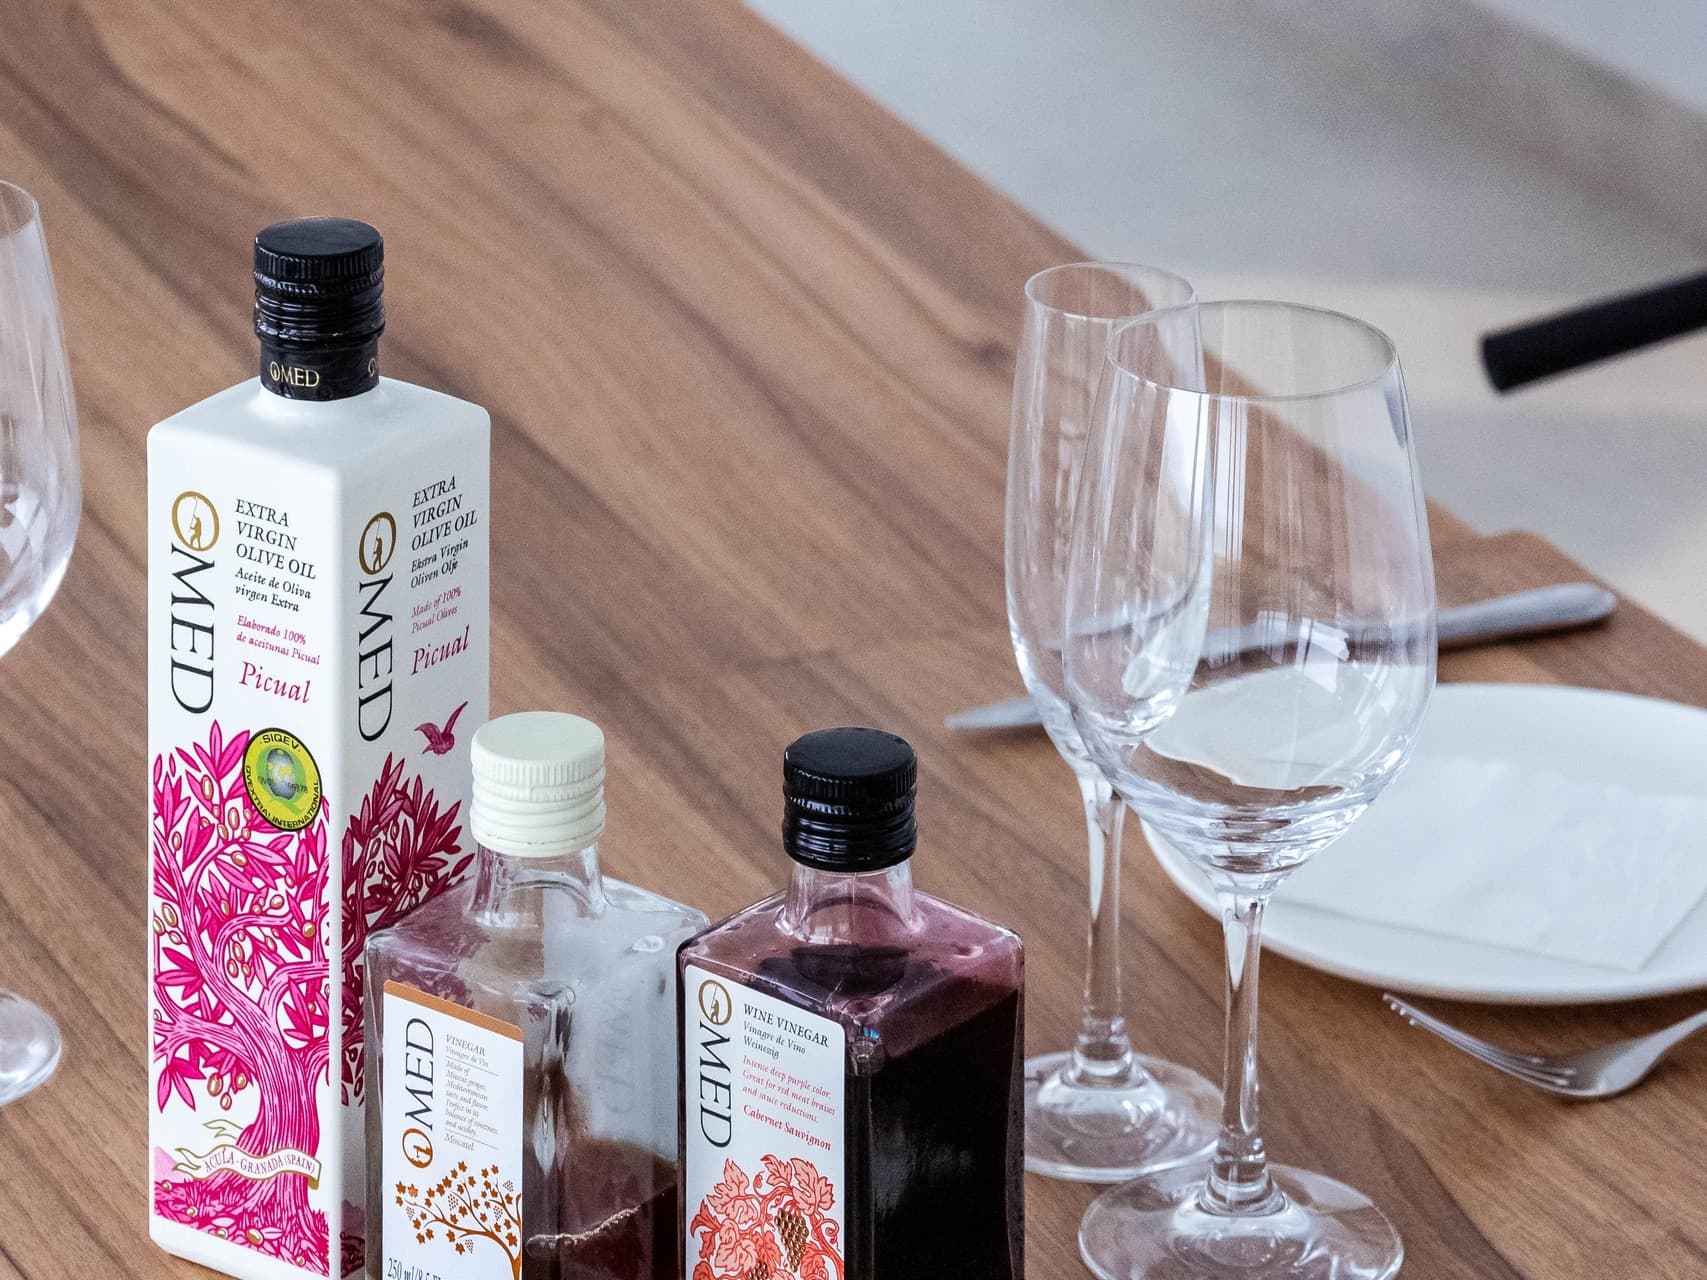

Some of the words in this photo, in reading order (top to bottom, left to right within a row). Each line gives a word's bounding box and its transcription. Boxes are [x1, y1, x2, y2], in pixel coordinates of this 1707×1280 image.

[270, 361, 319, 387] OMED
[412, 475, 456, 508] EXTRA
[235, 498, 289, 527] EXTRA
[412, 494, 463, 528] VIRGIN
[237, 521, 298, 551] VIRGIN
[411, 522, 452, 551] OLIVE
[454, 509, 478, 532] OIL
[236, 543, 284, 570] OLIVE
[289, 559, 317, 579] OIL
[411, 554, 437, 573] Ekstra
[440, 538, 469, 559] Virgin
[235, 567, 266, 585] Aceite
[268, 577, 280, 589] de
[282, 581, 311, 599] Oliva
[410, 571, 438, 589] Oliven
[441, 558, 458, 575] Olje
[171, 491, 219, 714] OMED
[235, 584, 268, 601] virgen
[270, 593, 299, 612] Extra
[412, 601, 433, 618] Made
[433, 594, 442, 610] of
[442, 586, 462, 603] 100%
[237, 615, 280, 637] Elaborado
[283, 629, 306, 645] 100%
[359, 512, 397, 741] OMED
[412, 613, 435, 634] Picual
[236, 631, 247, 642] de
[248, 638, 290, 656] aceitunas
[291, 647, 321, 665] Picual
[411, 624, 470, 675] Picual
[238, 661, 311, 704] Picual
[262, 733, 299, 750] SIQEV
[272, 782, 319, 829] INTERNATIONAL
[744, 1003, 774, 1025] WINE
[777, 1017, 829, 1048] VINEGAR
[744, 1020, 775, 1040] Vinagre
[776, 1034, 785, 1046] de
[787, 1039, 806, 1054] Vino
[446, 1034, 487, 1056] VINEGAR
[698, 979, 732, 1148] OMED
[743, 1055, 769, 1073] Intense
[770, 1066, 786, 1082] deep
[787, 1075, 811, 1091] purple
[402, 1018, 433, 1168] OMED
[743, 1069, 764, 1085] Great
[765, 1080, 776, 1089] for
[777, 1086, 790, 1096] red
[791, 1091, 810, 1105] meat
[743, 1086, 758, 1097] and
[444, 1132, 474, 1151] Moscatel
[743, 1104, 783, 1129] Cabernet
[784, 1121, 831, 1151] Sauvignon
[387, 1257, 402, 1280] 250
